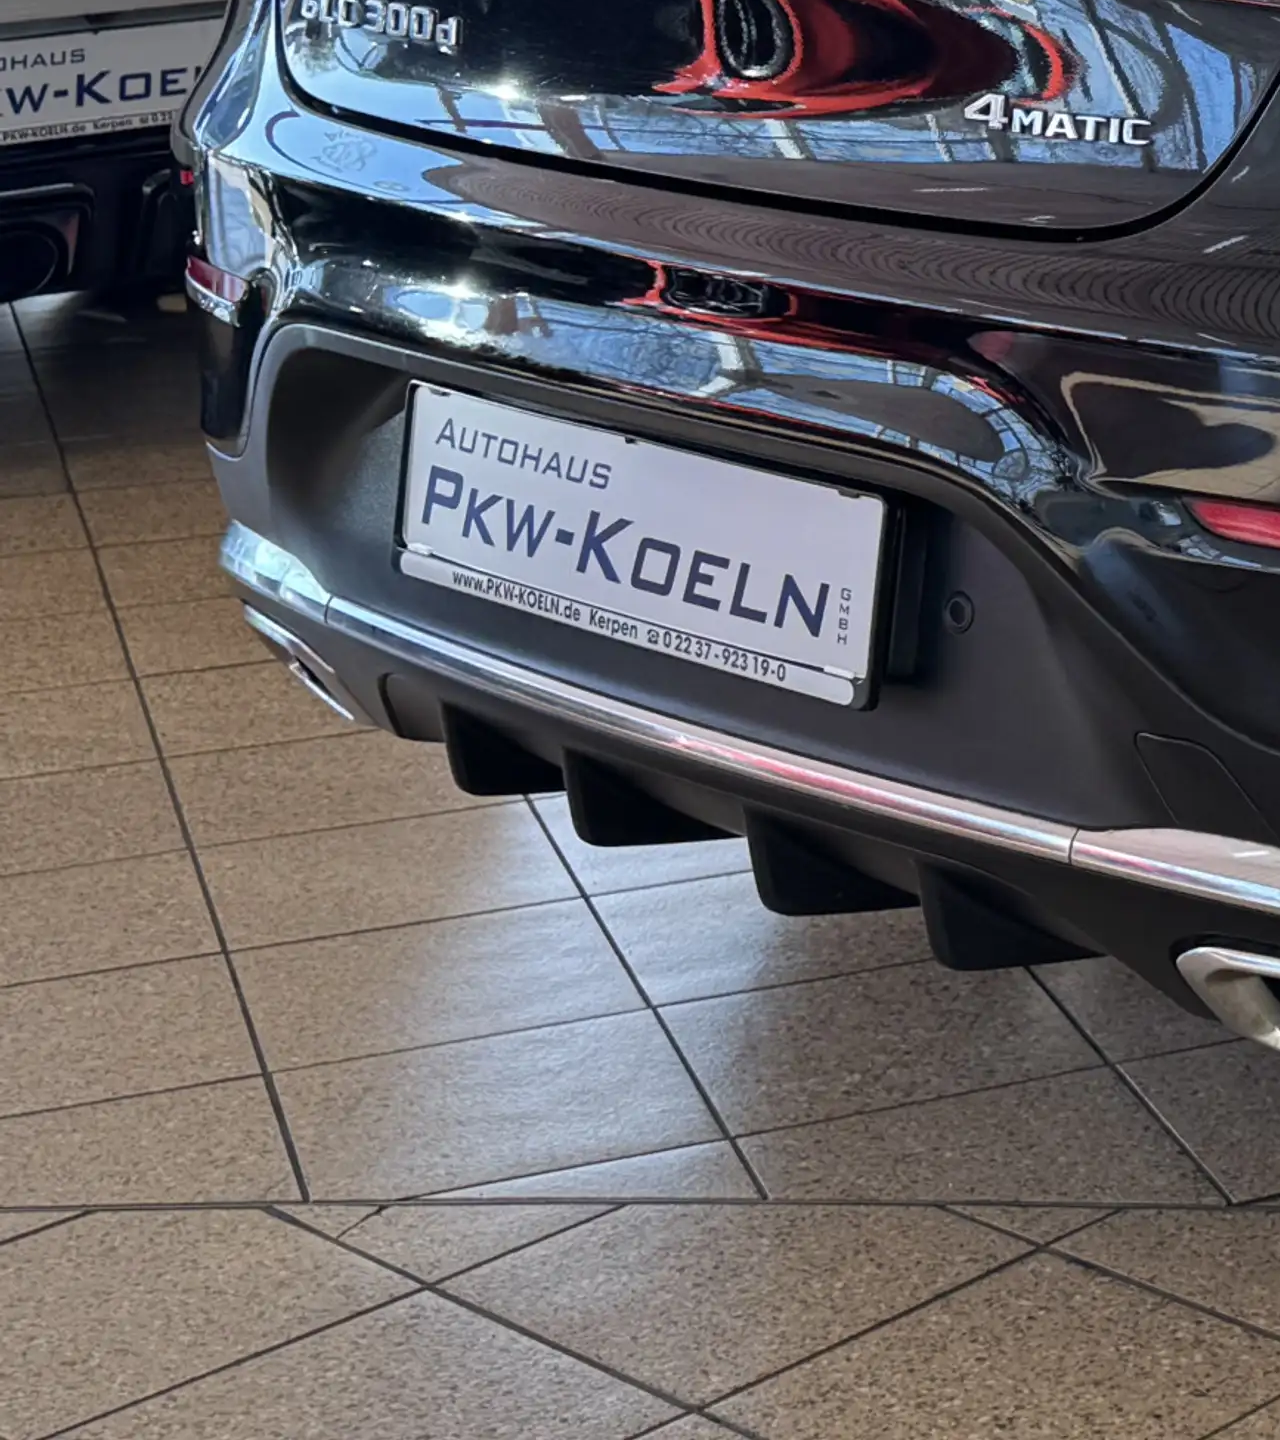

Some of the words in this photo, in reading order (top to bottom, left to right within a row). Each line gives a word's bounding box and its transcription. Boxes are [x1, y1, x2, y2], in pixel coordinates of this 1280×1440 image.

[963, 92, 1152, 146] 4MATIC
[435, 417, 613, 490] AUTOHAUS
[421, 464, 831, 639] PKW-KOELN
[451, 570, 581, 622] www.PKW-KOELN.de
[588, 608, 639, 640] Kerpen
